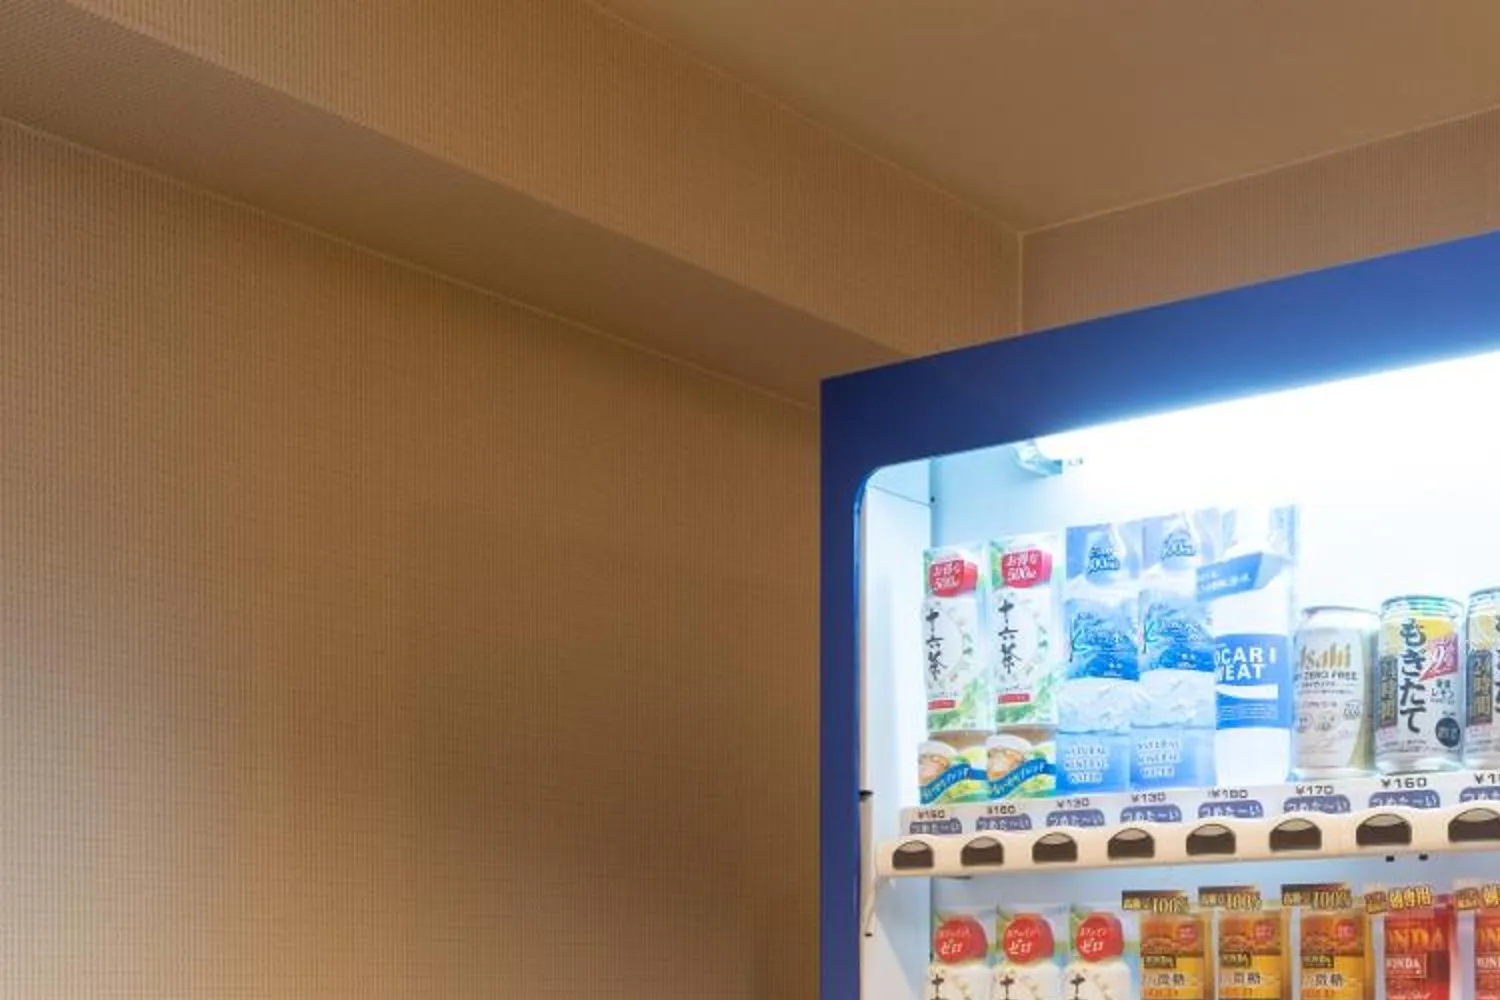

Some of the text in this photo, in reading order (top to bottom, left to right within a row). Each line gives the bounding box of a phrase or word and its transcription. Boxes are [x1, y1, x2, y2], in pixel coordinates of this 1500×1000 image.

[997, 598, 1022, 676] 十六茶
[1400, 617, 1427, 734] もぎたて
